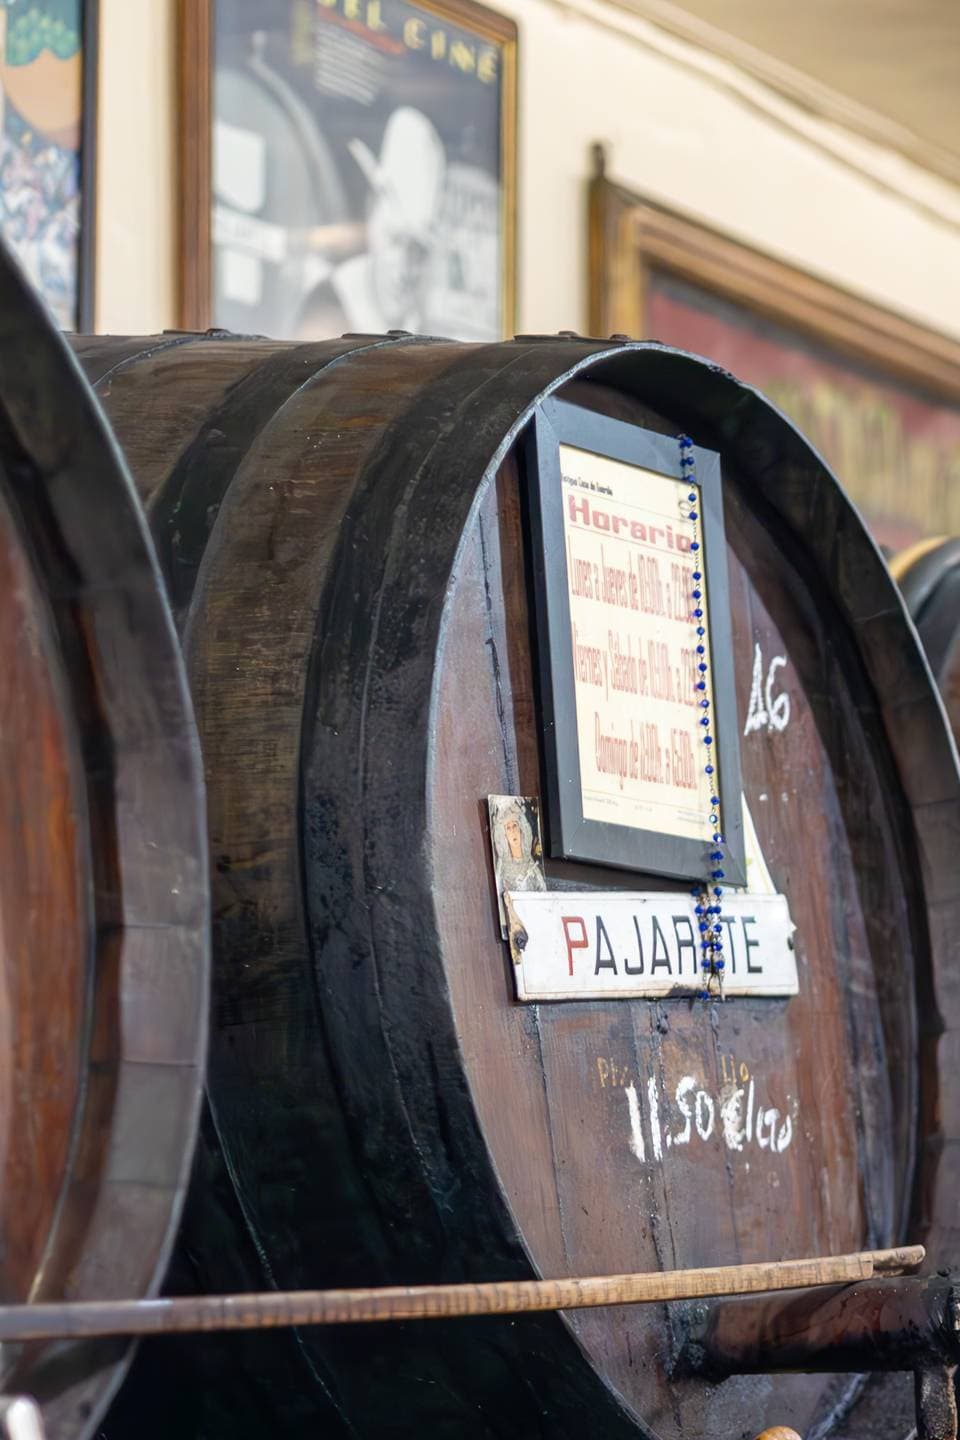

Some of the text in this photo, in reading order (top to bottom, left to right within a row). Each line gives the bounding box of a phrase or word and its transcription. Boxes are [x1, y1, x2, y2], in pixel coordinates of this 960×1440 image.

[317, 0, 386, 31] EL
[403, 17, 497, 84] CINE
[568, 494, 692, 554] Horario
[568, 535, 593, 599] Lunes
[593, 562, 600, 601] a
[601, 543, 627, 609] Jueves
[628, 551, 639, 611] de
[602, 650, 608, 702] y
[638, 636, 649, 697] de
[594, 711, 627, 790] Domingo
[628, 719, 638, 780] de
[561, 916, 763, 976] PAJARTE
